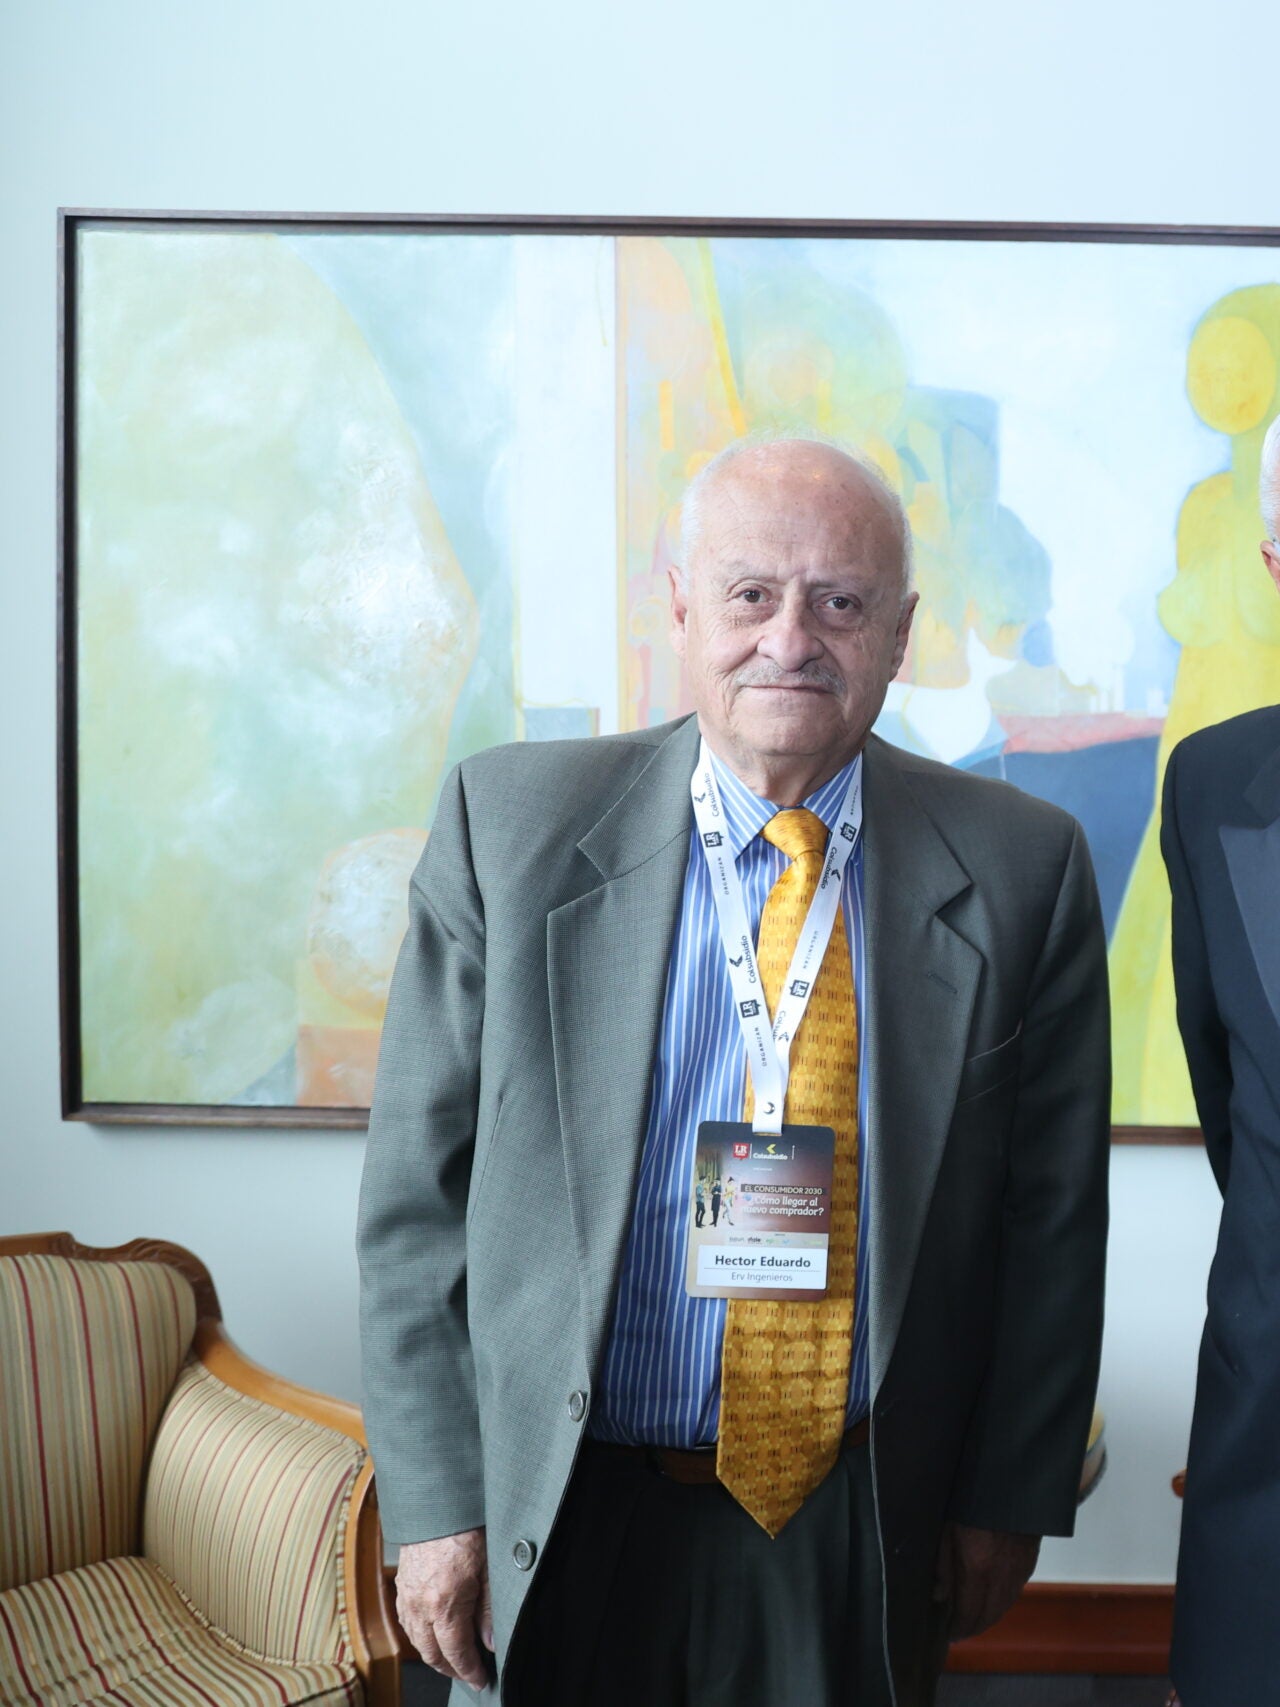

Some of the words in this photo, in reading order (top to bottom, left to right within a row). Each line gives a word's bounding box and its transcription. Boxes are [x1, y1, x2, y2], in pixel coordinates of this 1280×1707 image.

[705, 773, 719, 817] Colsubsidio
[821, 847, 837, 889] Colsubsidio
[718, 857, 729, 895] ORGANIZAN
[741, 935, 757, 983] Colsubsidio
[754, 1027, 767, 1066] ORGANIZAN
[735, 1145, 747, 1154] LR
[754, 1185, 804, 1194] CONSUMIDOR
[804, 1187, 823, 1195] 2030
[782, 1196, 807, 1208] llegar
[809, 1197, 818, 1206] al
[769, 1207, 824, 1217] comprador?
[715, 1255, 756, 1266] Hector
[760, 1256, 811, 1268] Eduardo
[731, 1272, 746, 1281] Erv
[747, 1272, 794, 1283] Ingenieros
